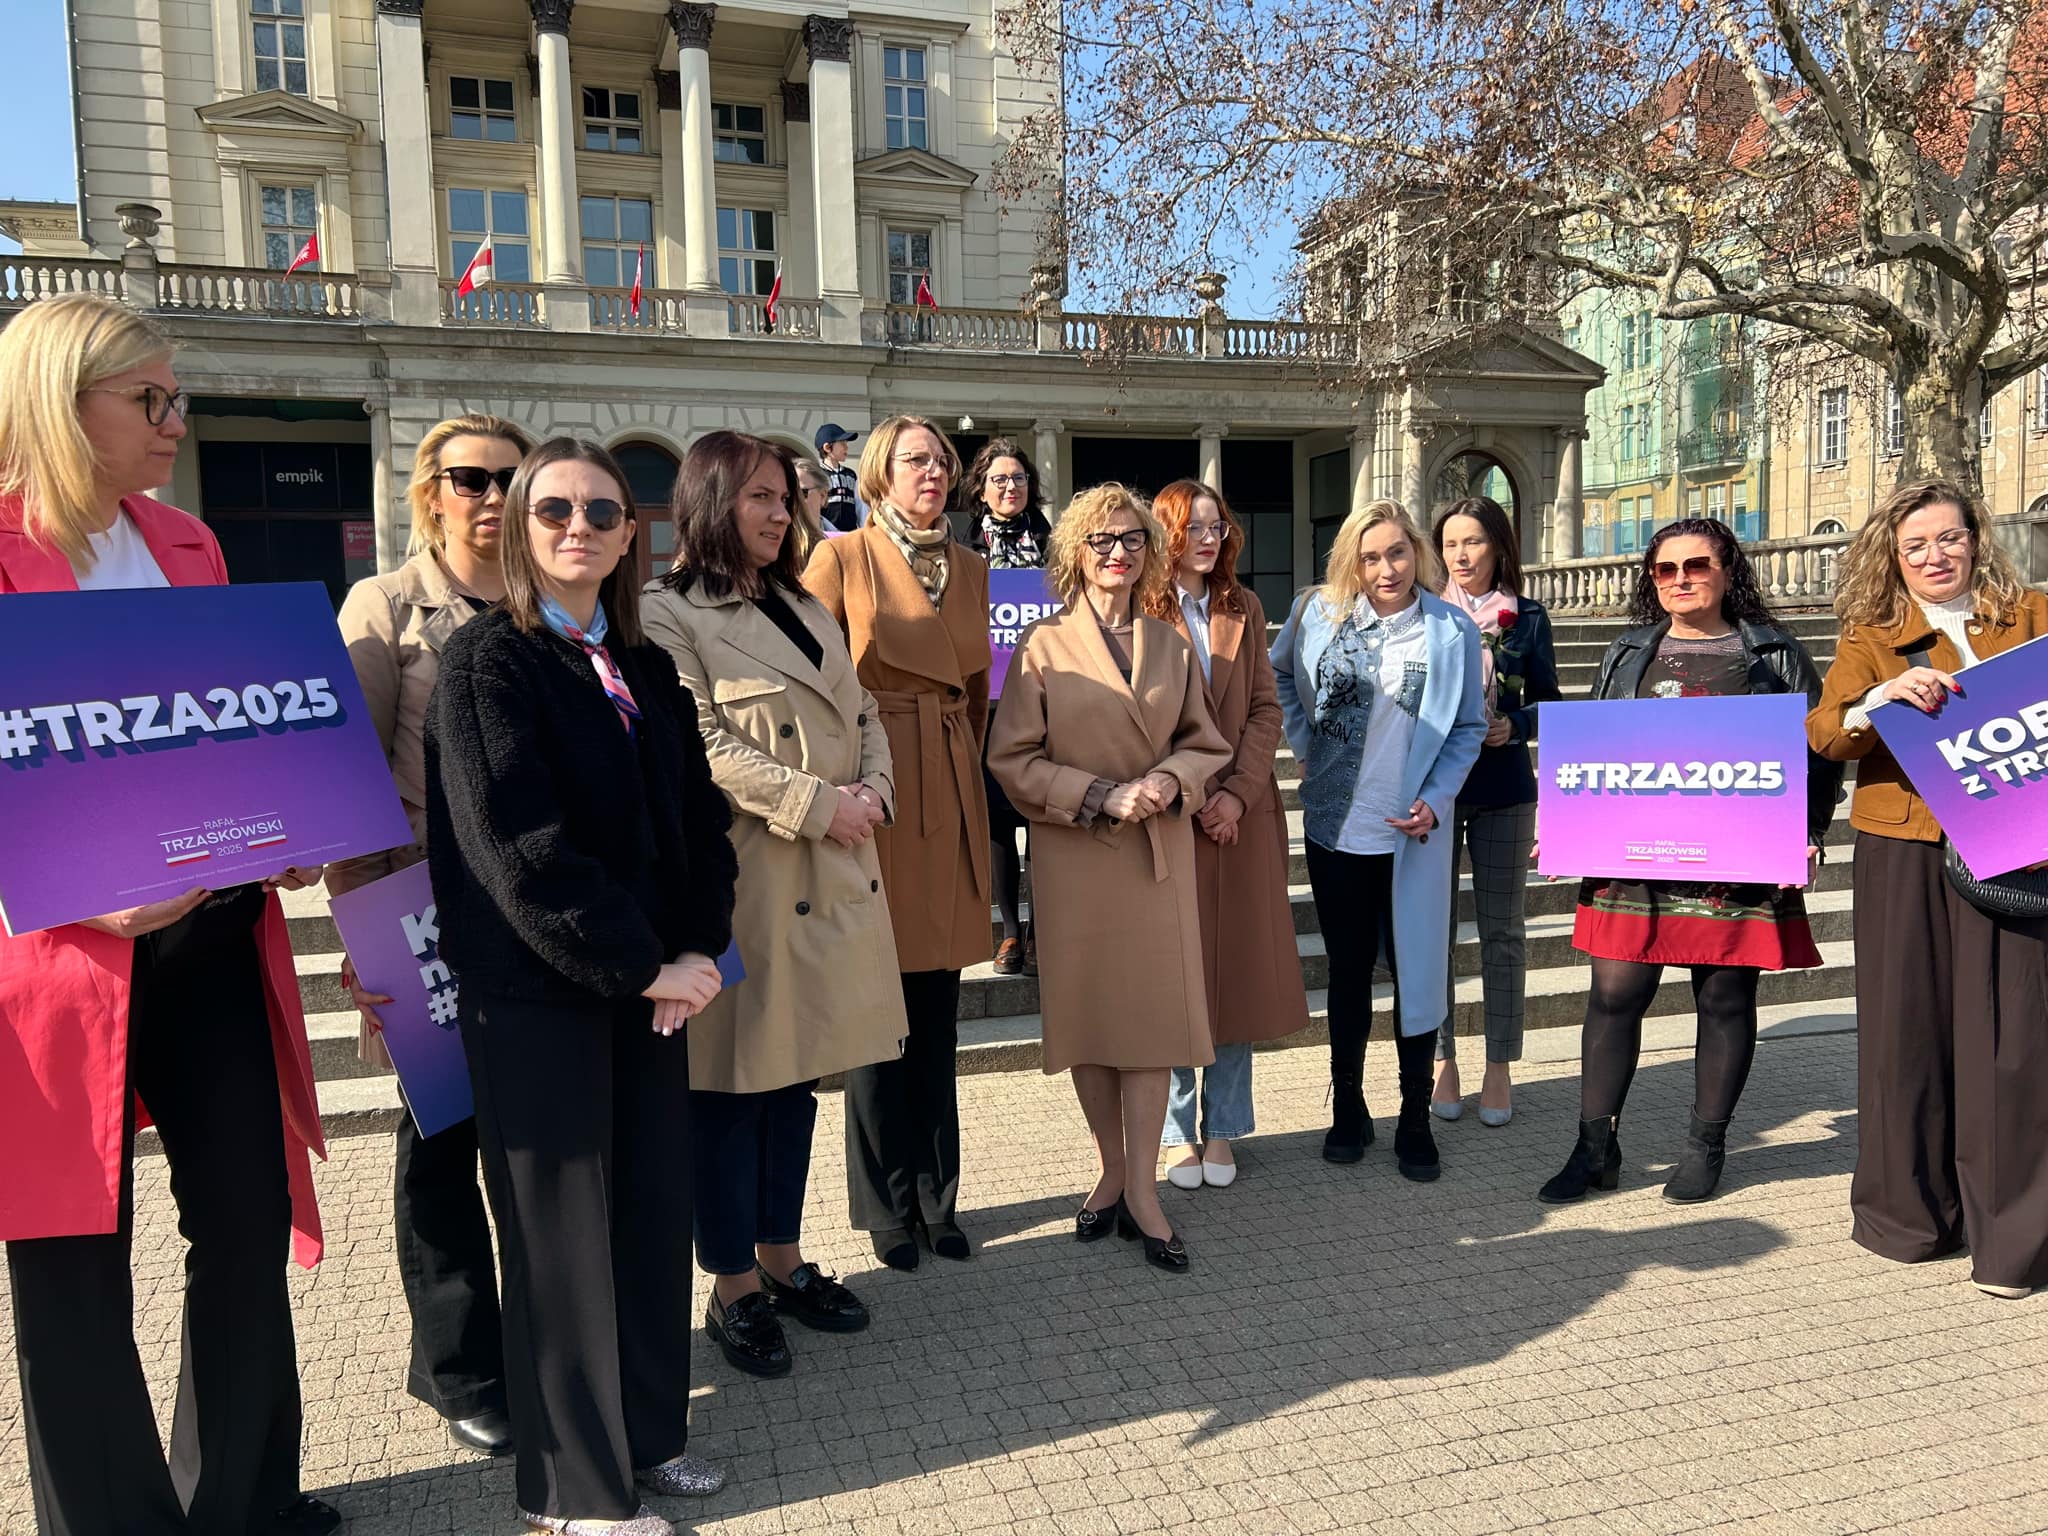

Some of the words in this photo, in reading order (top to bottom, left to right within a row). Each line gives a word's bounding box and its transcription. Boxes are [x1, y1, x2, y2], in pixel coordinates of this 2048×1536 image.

[275, 468, 323, 485] empik
[0, 677, 338, 759] #TRZA2025
[1555, 761, 1783, 790] #TRZA2025
[159, 818, 284, 853] TRZASKOWSKI
[216, 843, 243, 857] 2025
[1625, 846, 1707, 856] TRZASKOWSKI
